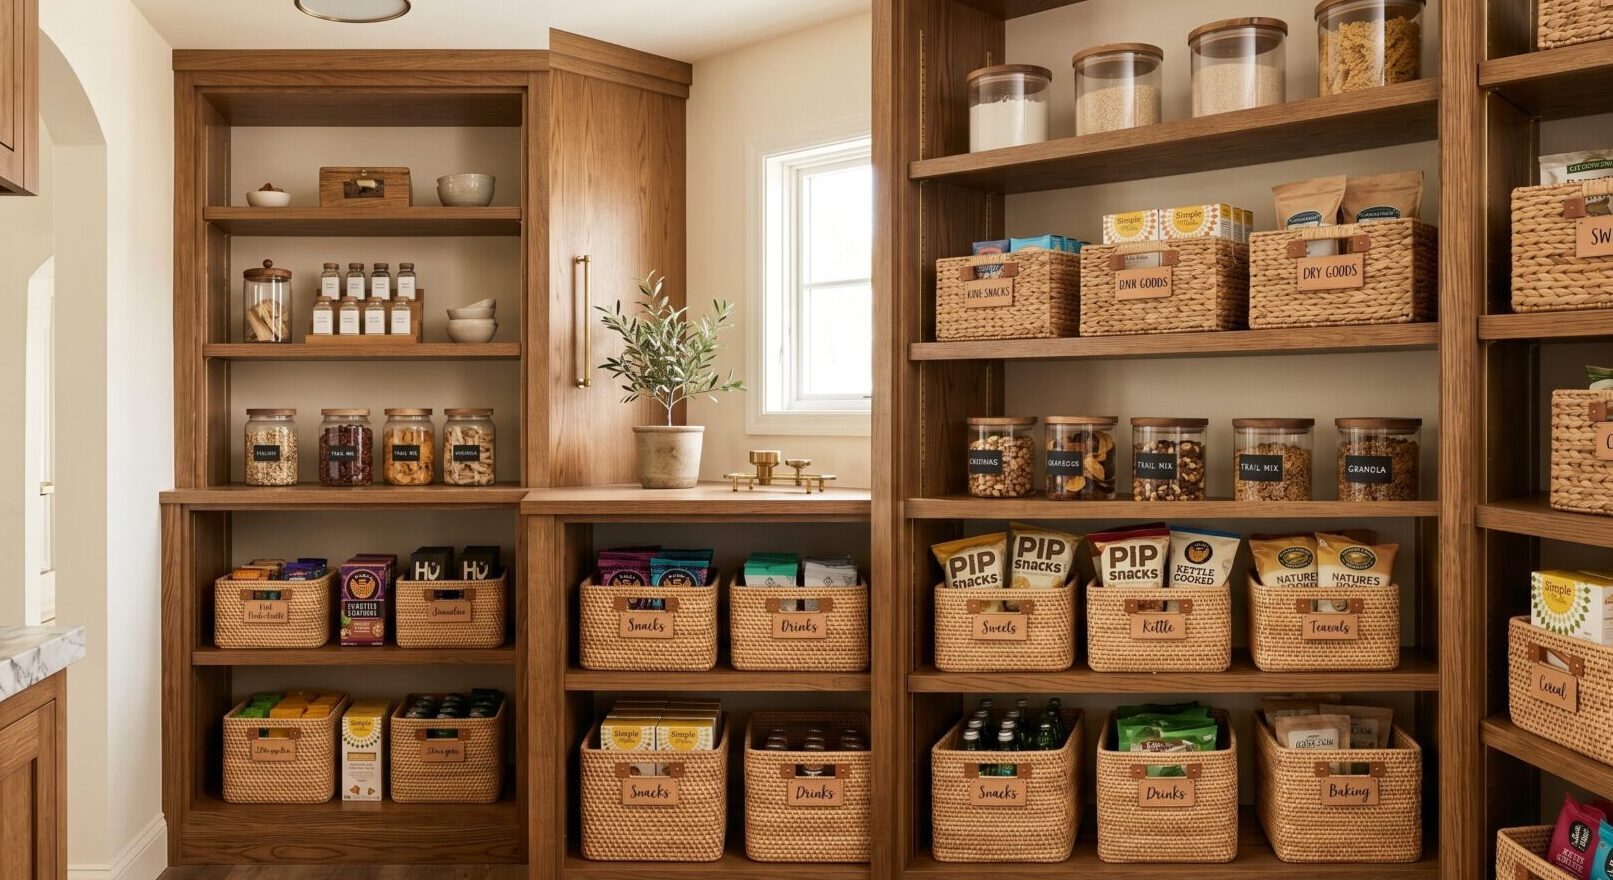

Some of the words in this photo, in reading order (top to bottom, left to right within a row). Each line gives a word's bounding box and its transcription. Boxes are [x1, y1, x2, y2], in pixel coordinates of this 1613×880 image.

[1117, 216, 1142, 225] Simple
[1175, 210, 1202, 220] Simple
[1303, 266, 1322, 280] DRY
[1325, 263, 1357, 278] GOODS
[984, 286, 1010, 298] SNACKS
[1137, 461, 1156, 470] TRAIL
[1240, 463, 1260, 472] TRAIL
[1263, 464, 1279, 472] MIX
[1348, 465, 1386, 473] GRANOLA
[1017, 536, 1065, 560] PIP
[1109, 544, 1158, 569] PIP
[948, 551, 995, 579] PIP
[1014, 559, 1062, 573] snacks
[1176, 564, 1215, 577] KETTLE
[952, 573, 998, 589] snacks
[1109, 568, 1158, 581] snacks
[1173, 573, 1214, 585] COOKED
[1332, 572, 1380, 585] NATURES
[1544, 580, 1572, 596] Simple
[628, 617, 666, 632] Snacks
[781, 618, 818, 632] Drinks
[1142, 619, 1175, 633] Kettle
[1539, 674, 1567, 700] Cereal
[671, 731, 695, 739] Simple
[630, 784, 671, 799] Snacks
[796, 784, 835, 800] Drinks
[979, 784, 1018, 799] Snacks
[1146, 784, 1186, 800] Drinks
[1329, 783, 1371, 802] Baking
